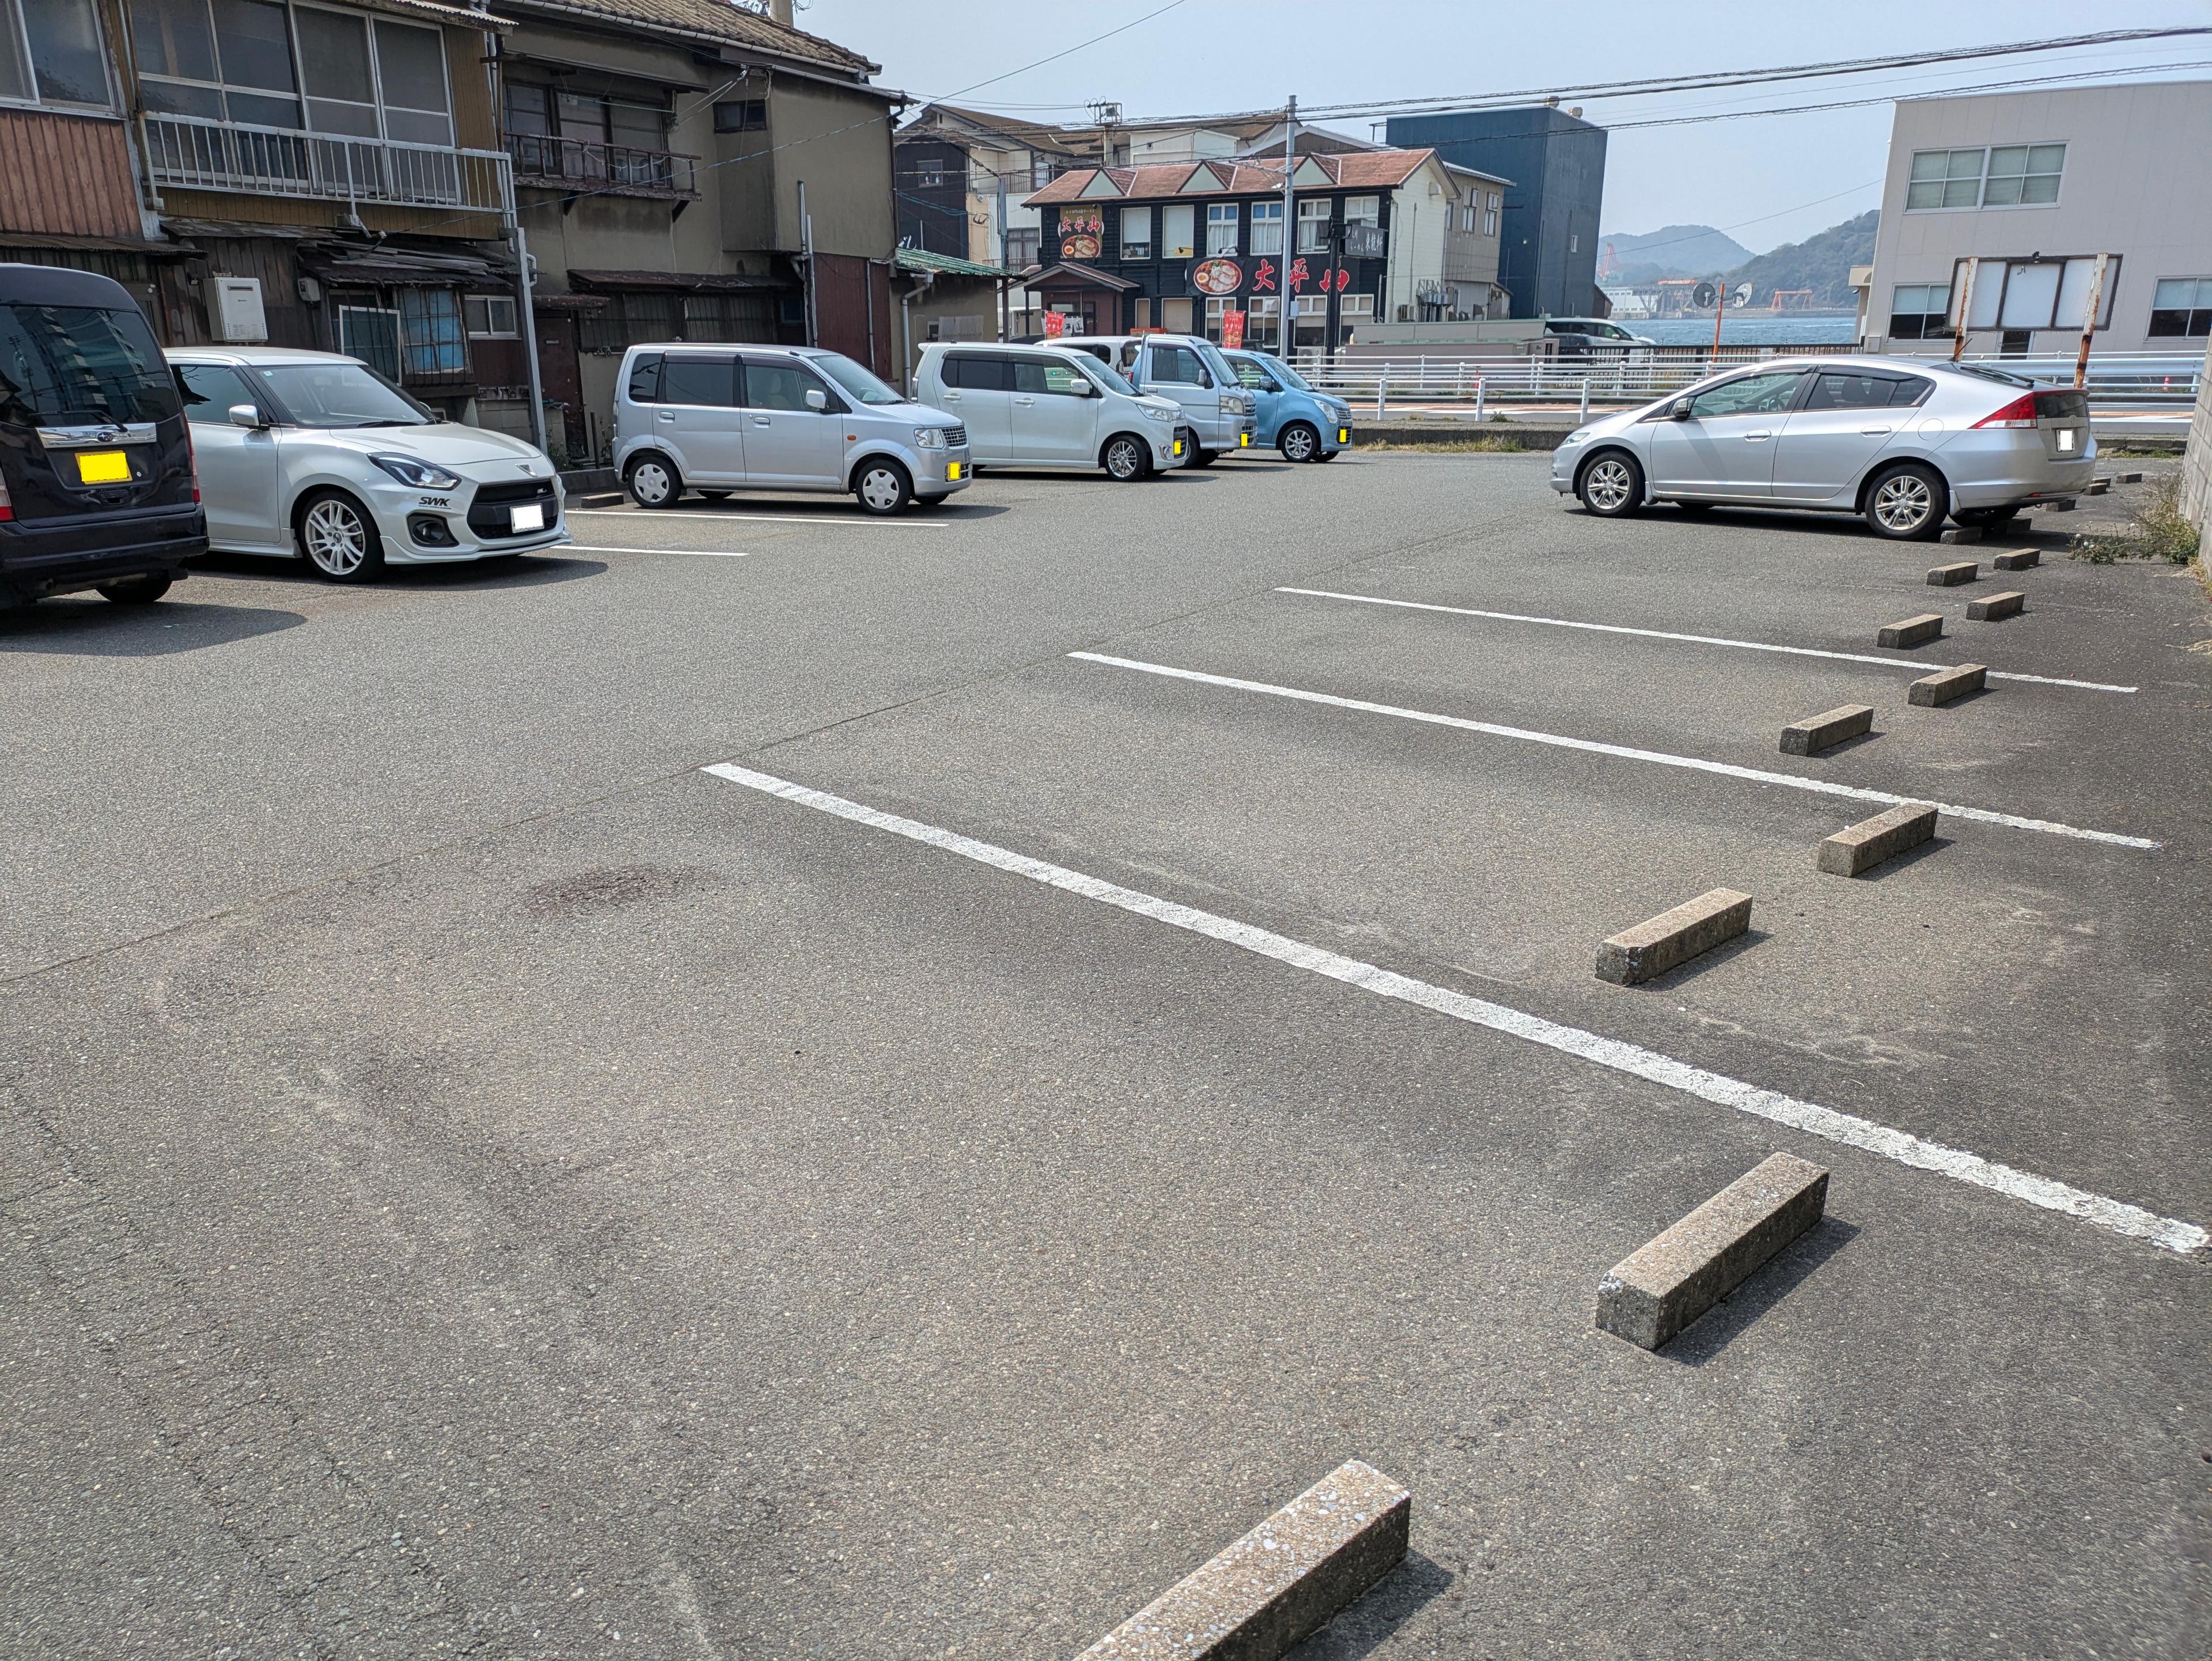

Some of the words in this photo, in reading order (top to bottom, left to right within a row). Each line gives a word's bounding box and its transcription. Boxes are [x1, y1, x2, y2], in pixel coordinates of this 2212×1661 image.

[1061, 214, 1101, 233] 大平山
[1350, 241, 1364, 252] らーめん
[418, 496, 451, 507] SWK
